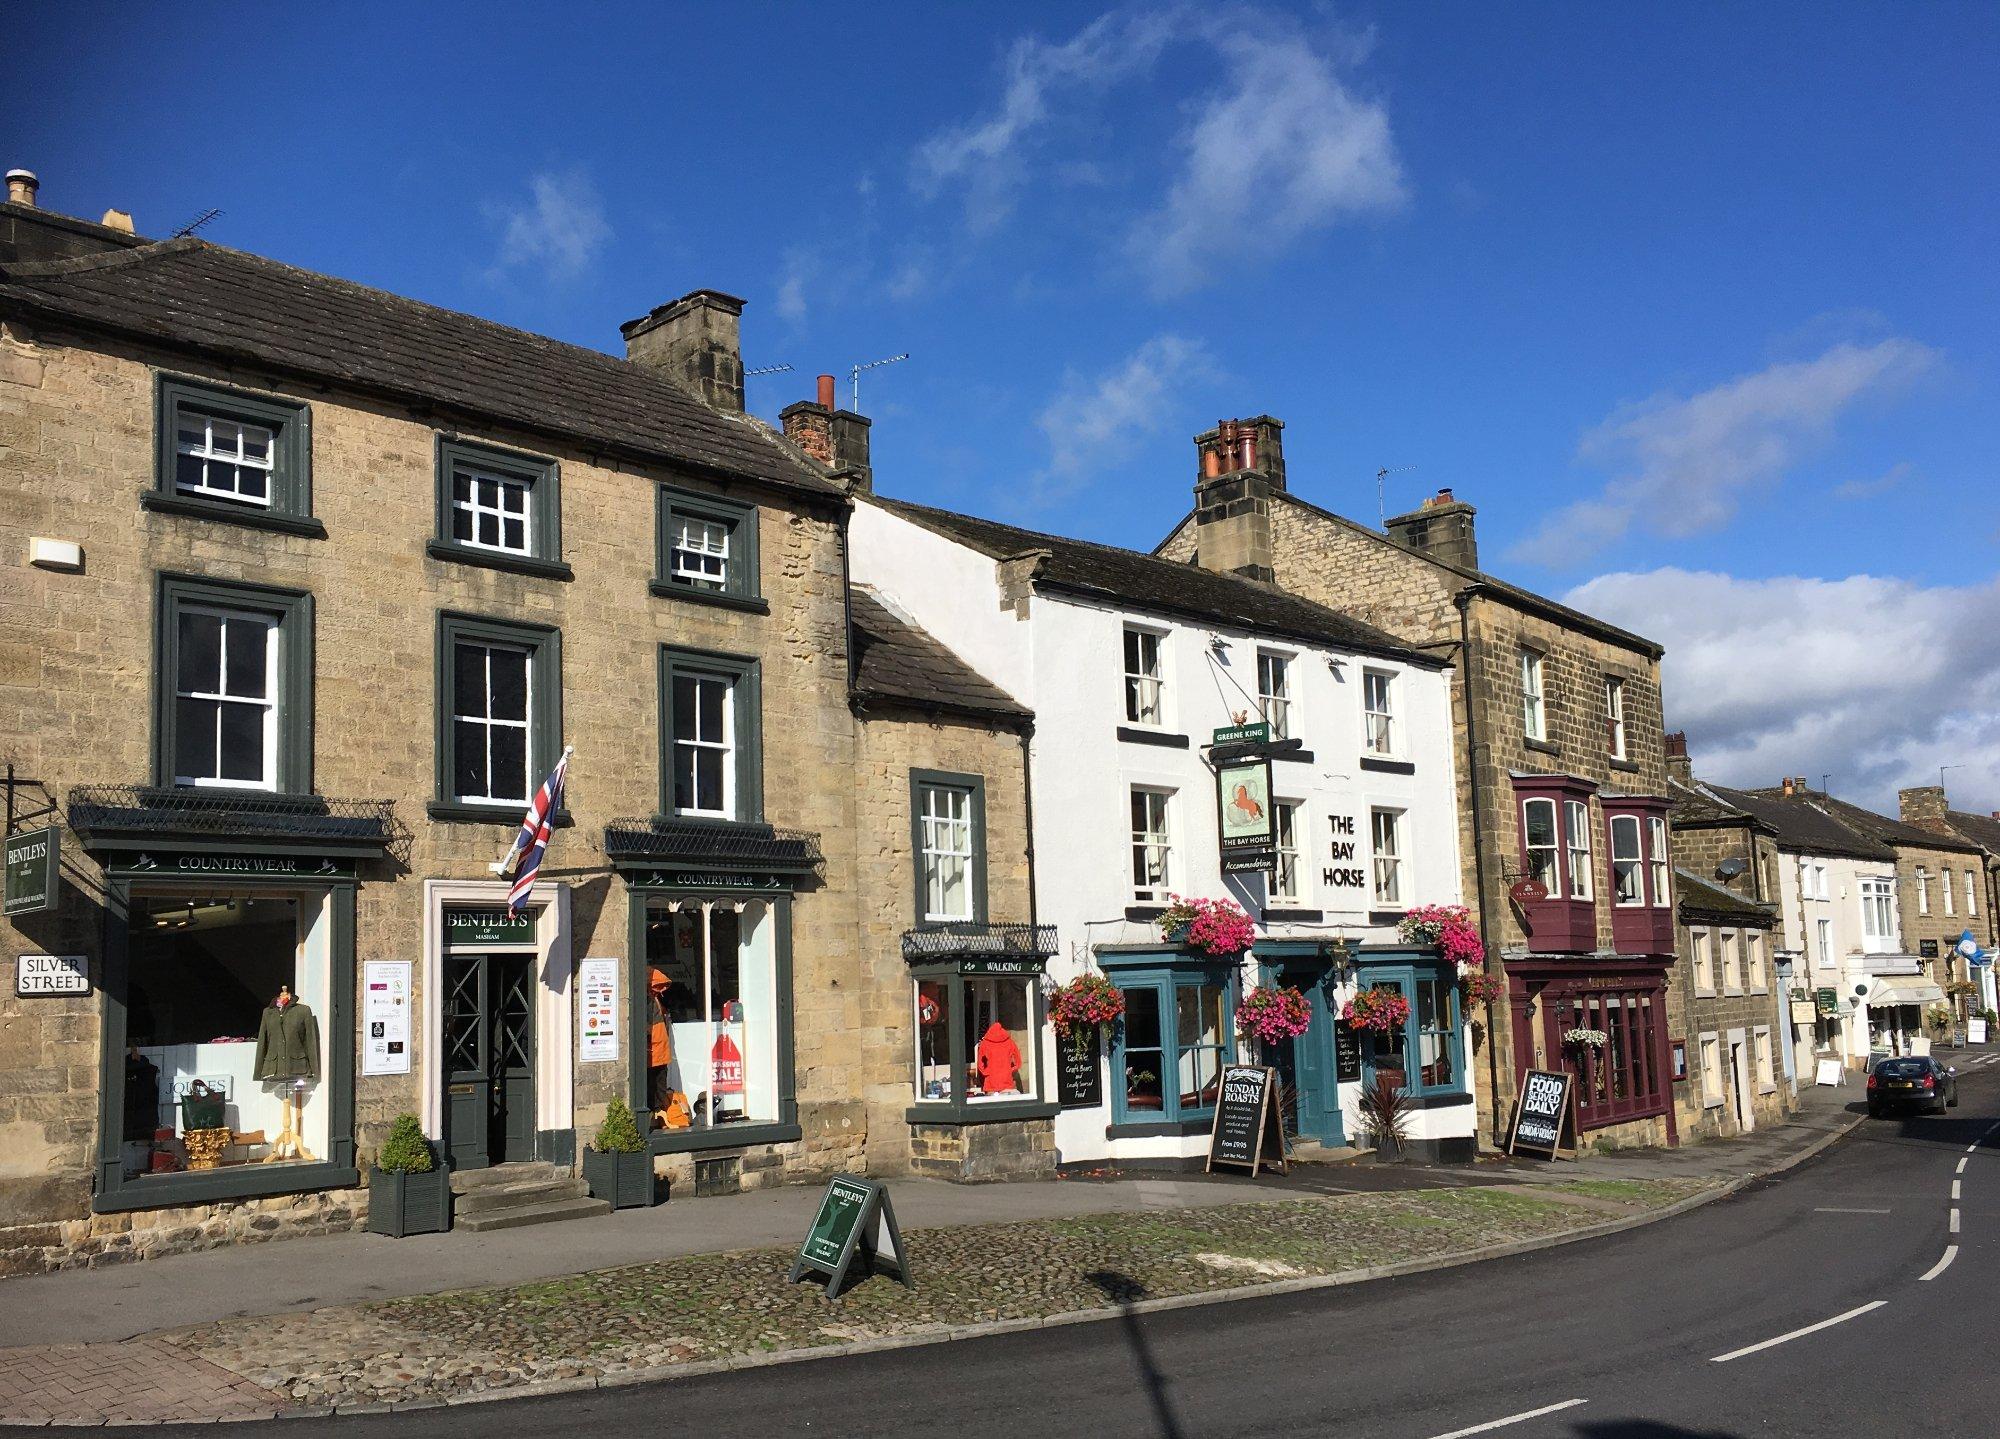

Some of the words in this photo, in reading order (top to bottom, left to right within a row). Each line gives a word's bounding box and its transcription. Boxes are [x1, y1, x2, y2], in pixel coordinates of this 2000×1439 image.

[1216, 732, 1244, 741] GREENE
[1245, 729, 1263, 738] KING
[1328, 814, 1355, 835] THE
[1223, 838, 1236, 846] THE
[1237, 837, 1249, 845] BAY
[1250, 835, 1271, 844] HORSE
[8, 842, 46, 865] BENTLEYS
[1331, 841, 1356, 861] BAY
[178, 856, 297, 872] COUNTRYWEAR
[1225, 857, 1273, 871] Accommodation
[676, 873, 754, 886] COUNTRYWEAR
[1322, 867, 1365, 889] HORSE
[447, 913, 528, 927] BENTLEYS
[27, 958, 80, 972] SILVER
[986, 962, 1022, 972] WALKING
[22, 976, 84, 989] STREET
[712, 1068, 742, 1081] SALE
[1225, 1083, 1262, 1095] SUNDAY
[1529, 1078, 1563, 1095] FOOD
[1225, 1093, 1259, 1104] ROASTS
[1528, 1090, 1560, 1104] SERVED
[1525, 1100, 1560, 1115] DAILY
[832, 1186, 864, 1203] BENTLEYS
